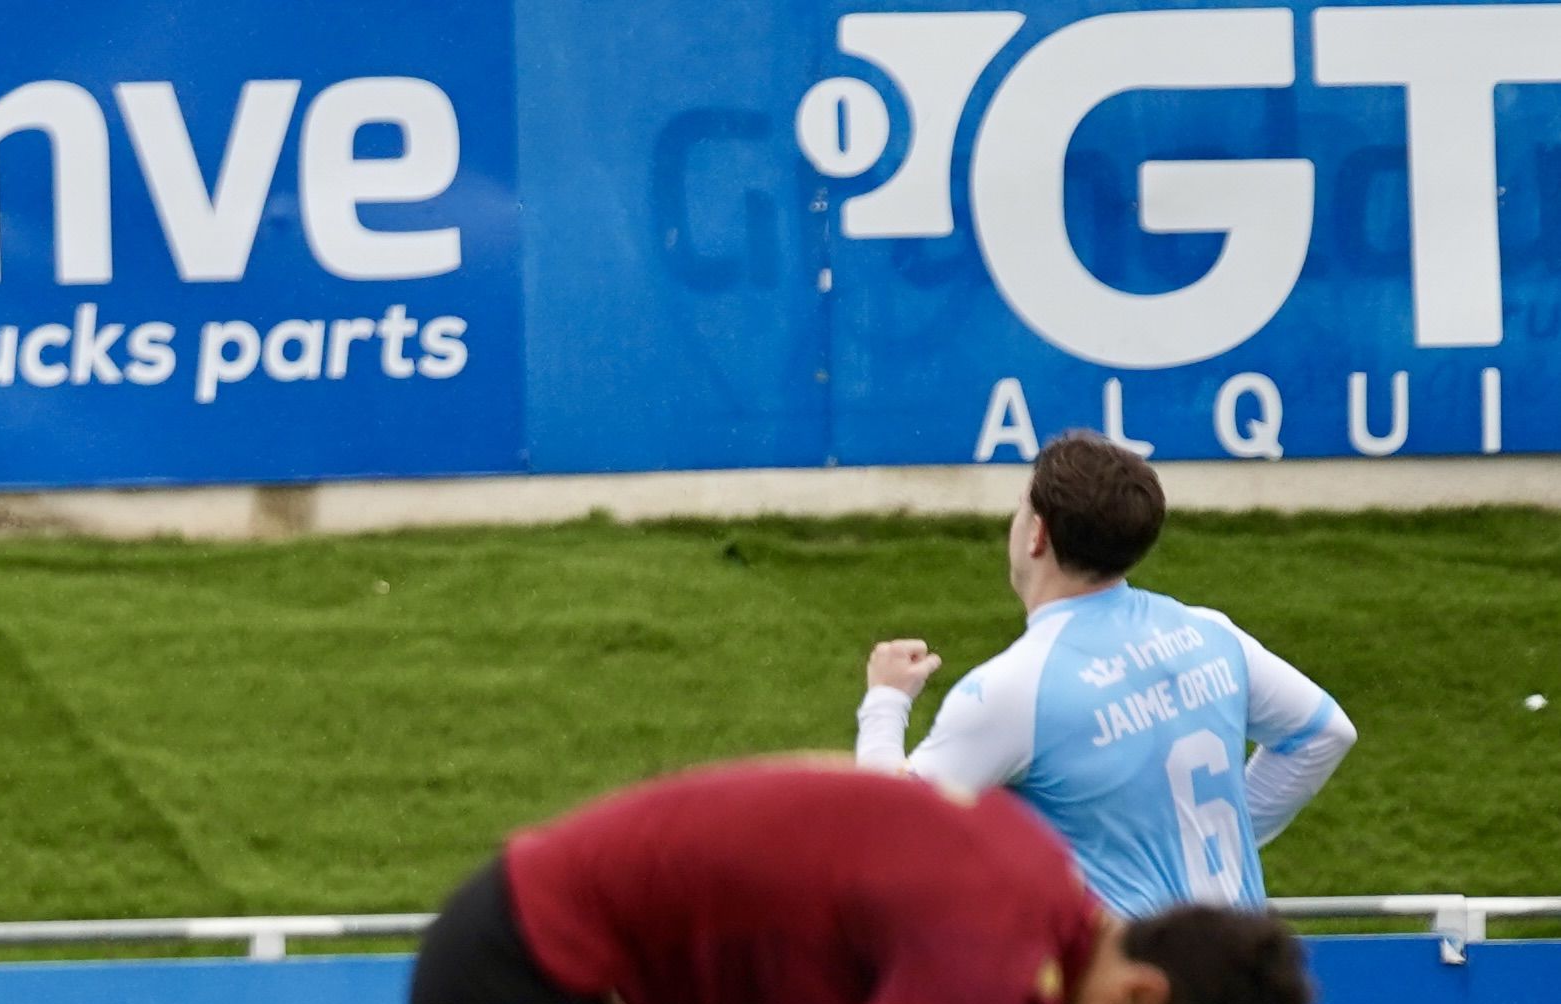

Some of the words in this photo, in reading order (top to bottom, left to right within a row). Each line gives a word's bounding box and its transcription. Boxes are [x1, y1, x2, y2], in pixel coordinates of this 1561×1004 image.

[194, 304, 468, 403] parts
[1092, 680, 1179, 746] JAIME
[1178, 656, 1239, 710] ORTIZ
[1166, 729, 1246, 905] 6
